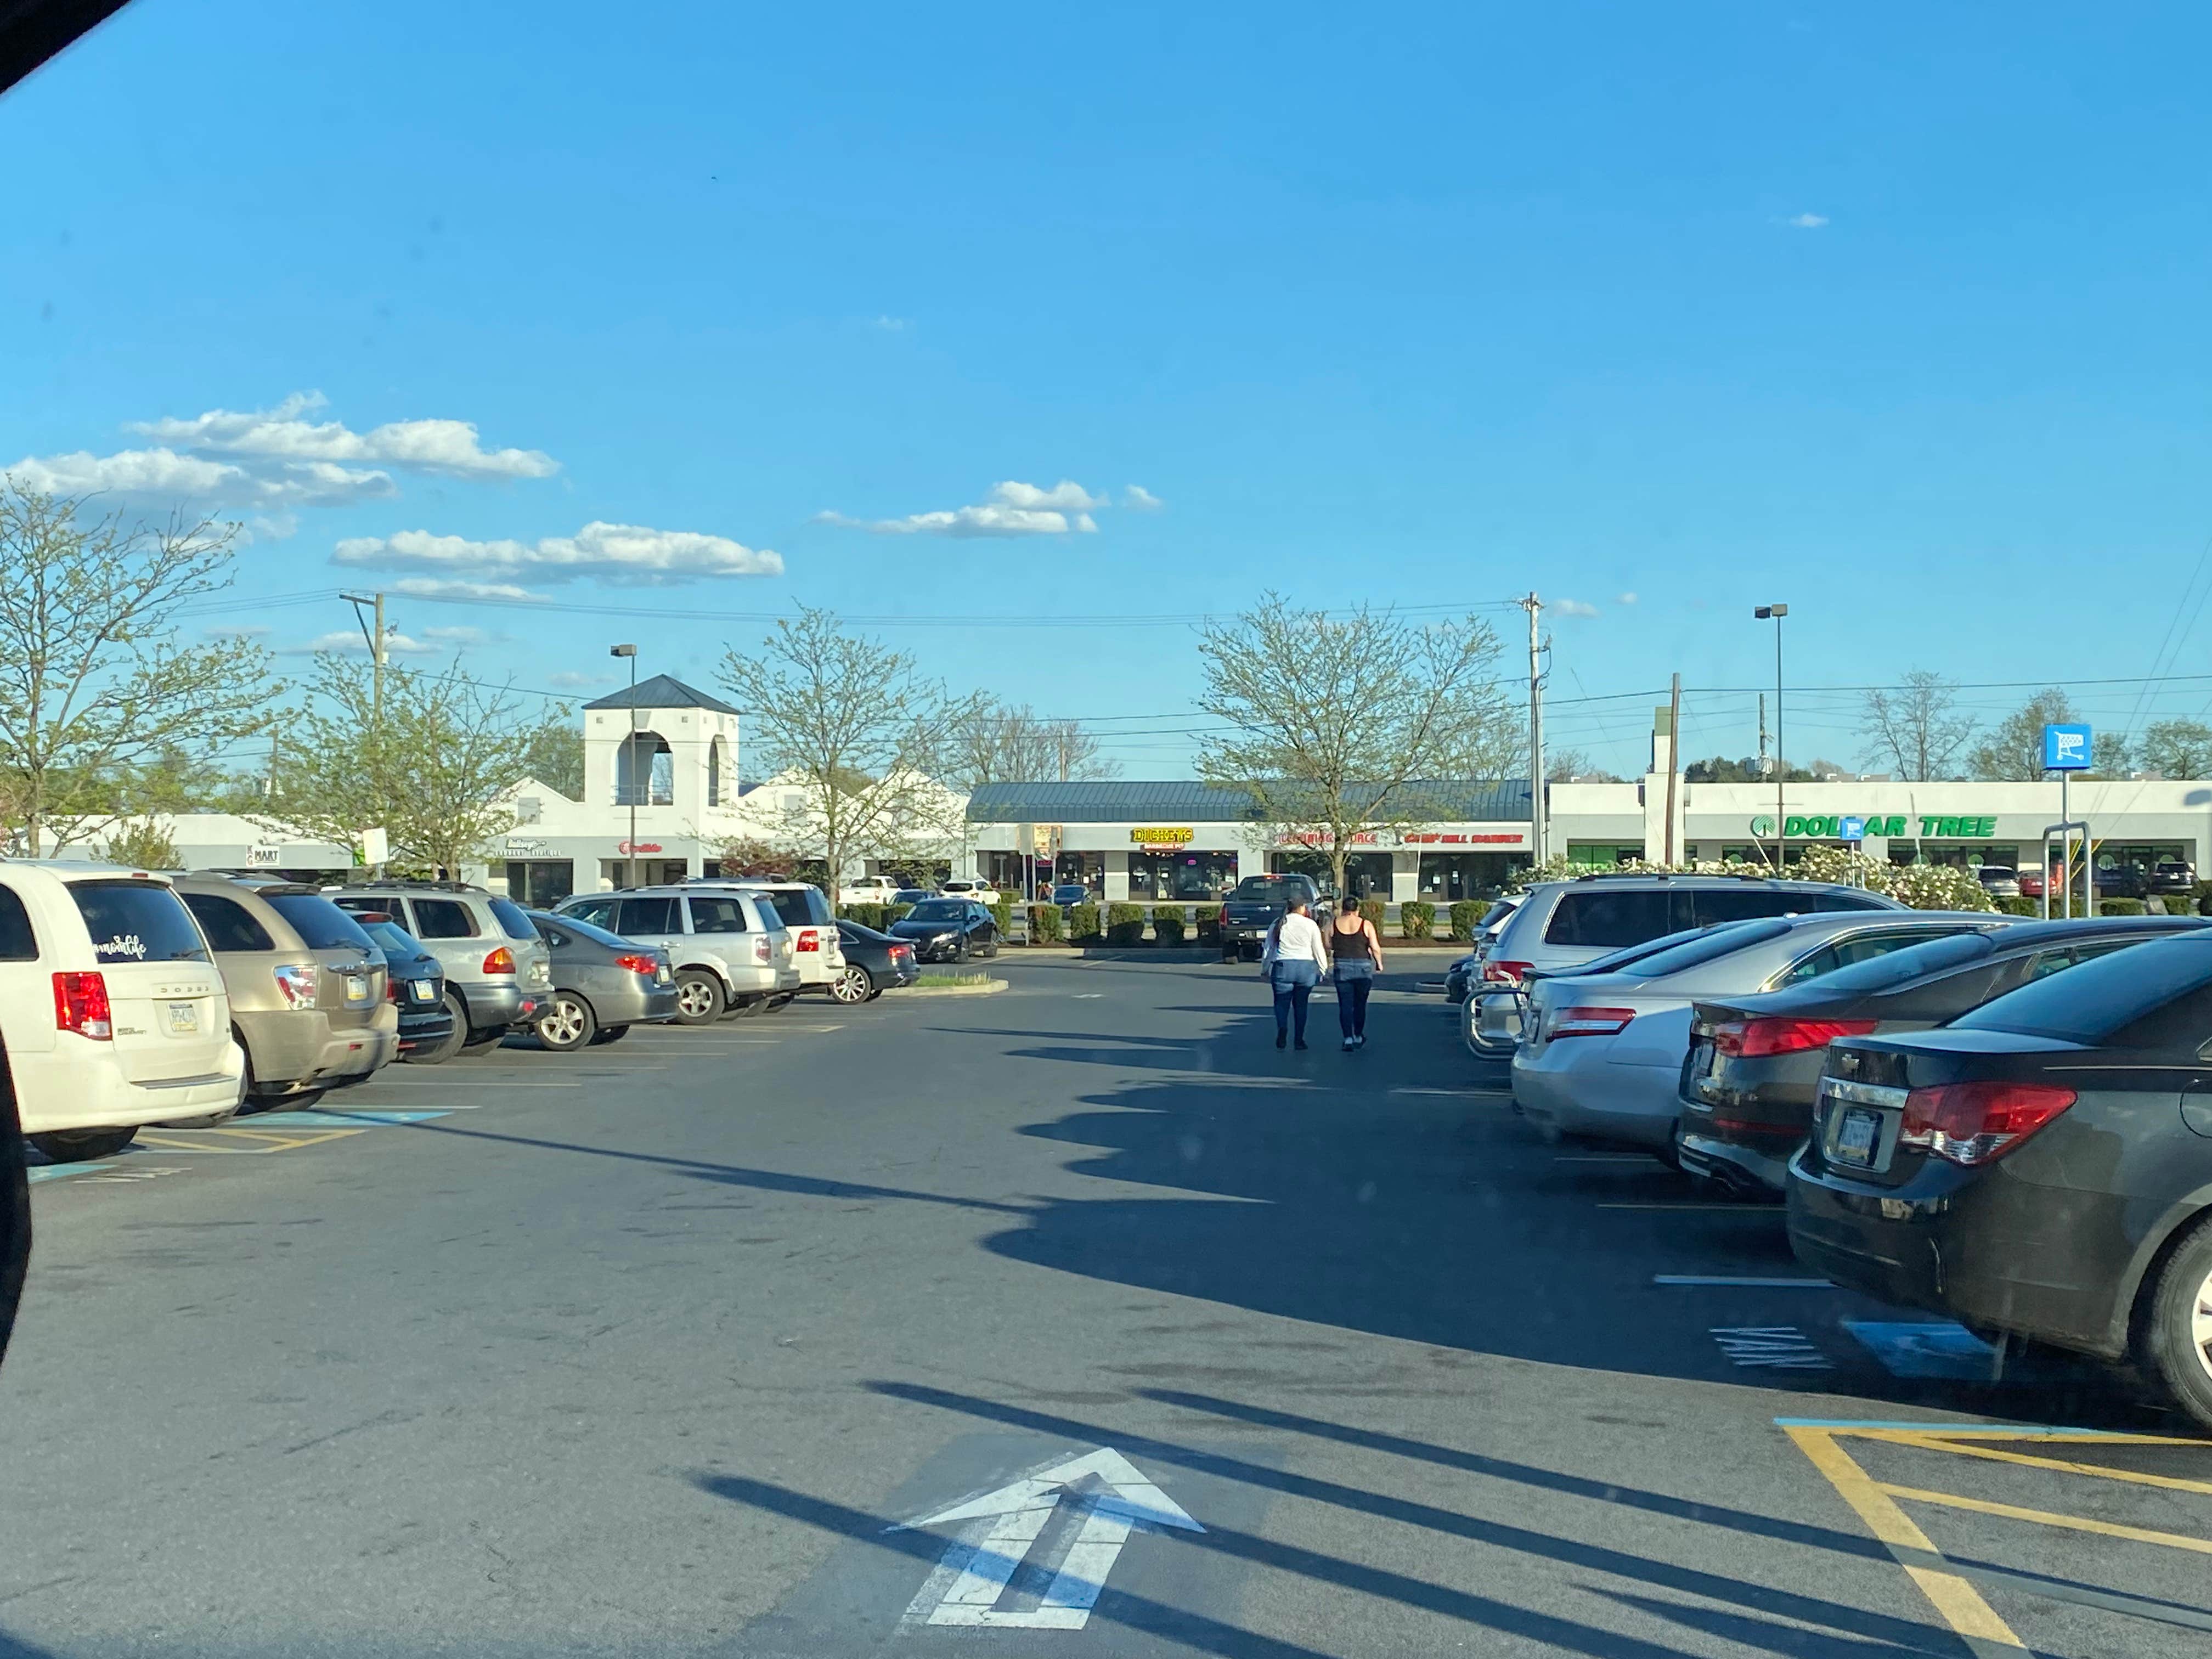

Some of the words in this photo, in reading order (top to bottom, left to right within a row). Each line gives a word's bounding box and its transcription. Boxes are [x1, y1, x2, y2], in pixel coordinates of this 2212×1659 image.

[1784, 816, 1907, 837] DOLAR
[1918, 816, 1997, 837] TREE
[255, 850, 278, 861] MART
